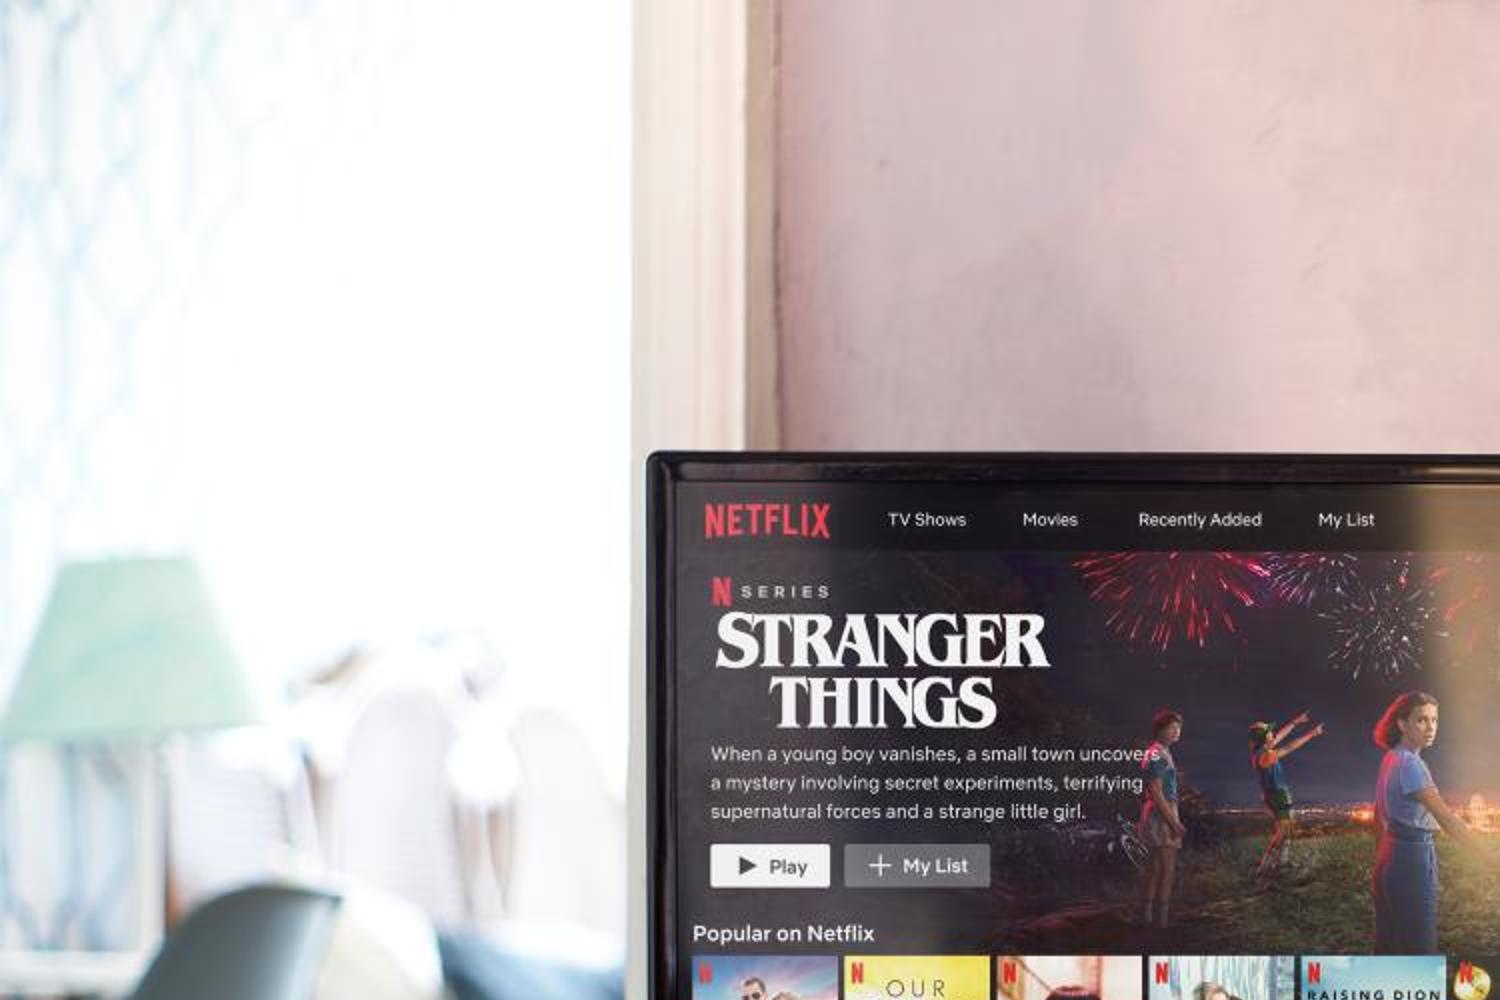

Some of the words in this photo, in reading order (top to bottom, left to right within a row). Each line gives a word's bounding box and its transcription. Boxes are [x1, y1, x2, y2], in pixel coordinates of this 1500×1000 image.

[704, 502, 831, 538] NETFLIX
[888, 512, 911, 527] TV
[915, 512, 967, 527] Shows
[1023, 512, 1079, 527] Movies
[1138, 512, 1206, 529] Recently
[1209, 512, 1263, 527] Added
[1318, 512, 1343, 529] My
[1346, 512, 1375, 527] List
[741, 585, 830, 599] SERIES
[715, 610, 1051, 669] STRANGER
[768, 675, 998, 730] THINGS
[710, 745, 763, 762] When
[767, 748, 778, 762] a
[782, 749, 837, 765] young
[842, 746, 874, 765] boy
[880, 746, 961, 764] vanishes,
[966, 749, 977, 762] a
[981, 746, 1027, 762] small
[1032, 747, 1075, 762] town
[1079, 749, 1161, 762] uncovers
[710, 777, 721, 790] a
[725, 775, 797, 795] mystery
[801, 775, 880, 795] involving
[884, 775, 939, 791] secret
[943, 776, 1059, 794] experiments,
[1063, 775, 1143, 795] terrifying
[710, 804, 822, 823] supernatural
[826, 803, 881, 820] forces
[885, 803, 919, 820] and
[923, 807, 934, 820] a
[939, 804, 1005, 823] strange
[1011, 803, 1049, 820] little
[1053, 803, 1087, 823] girl.
[769, 858, 808, 878] Play
[903, 858, 931, 877] My
[935, 857, 969, 874] List
[693, 924, 772, 946] Popular
[776, 928, 802, 943] on
[807, 924, 875, 942] Netflix
[885, 979, 946, 998] OUR
[1307, 989, 1384, 1000] RAISING
[1393, 989, 1441, 1000] DION
